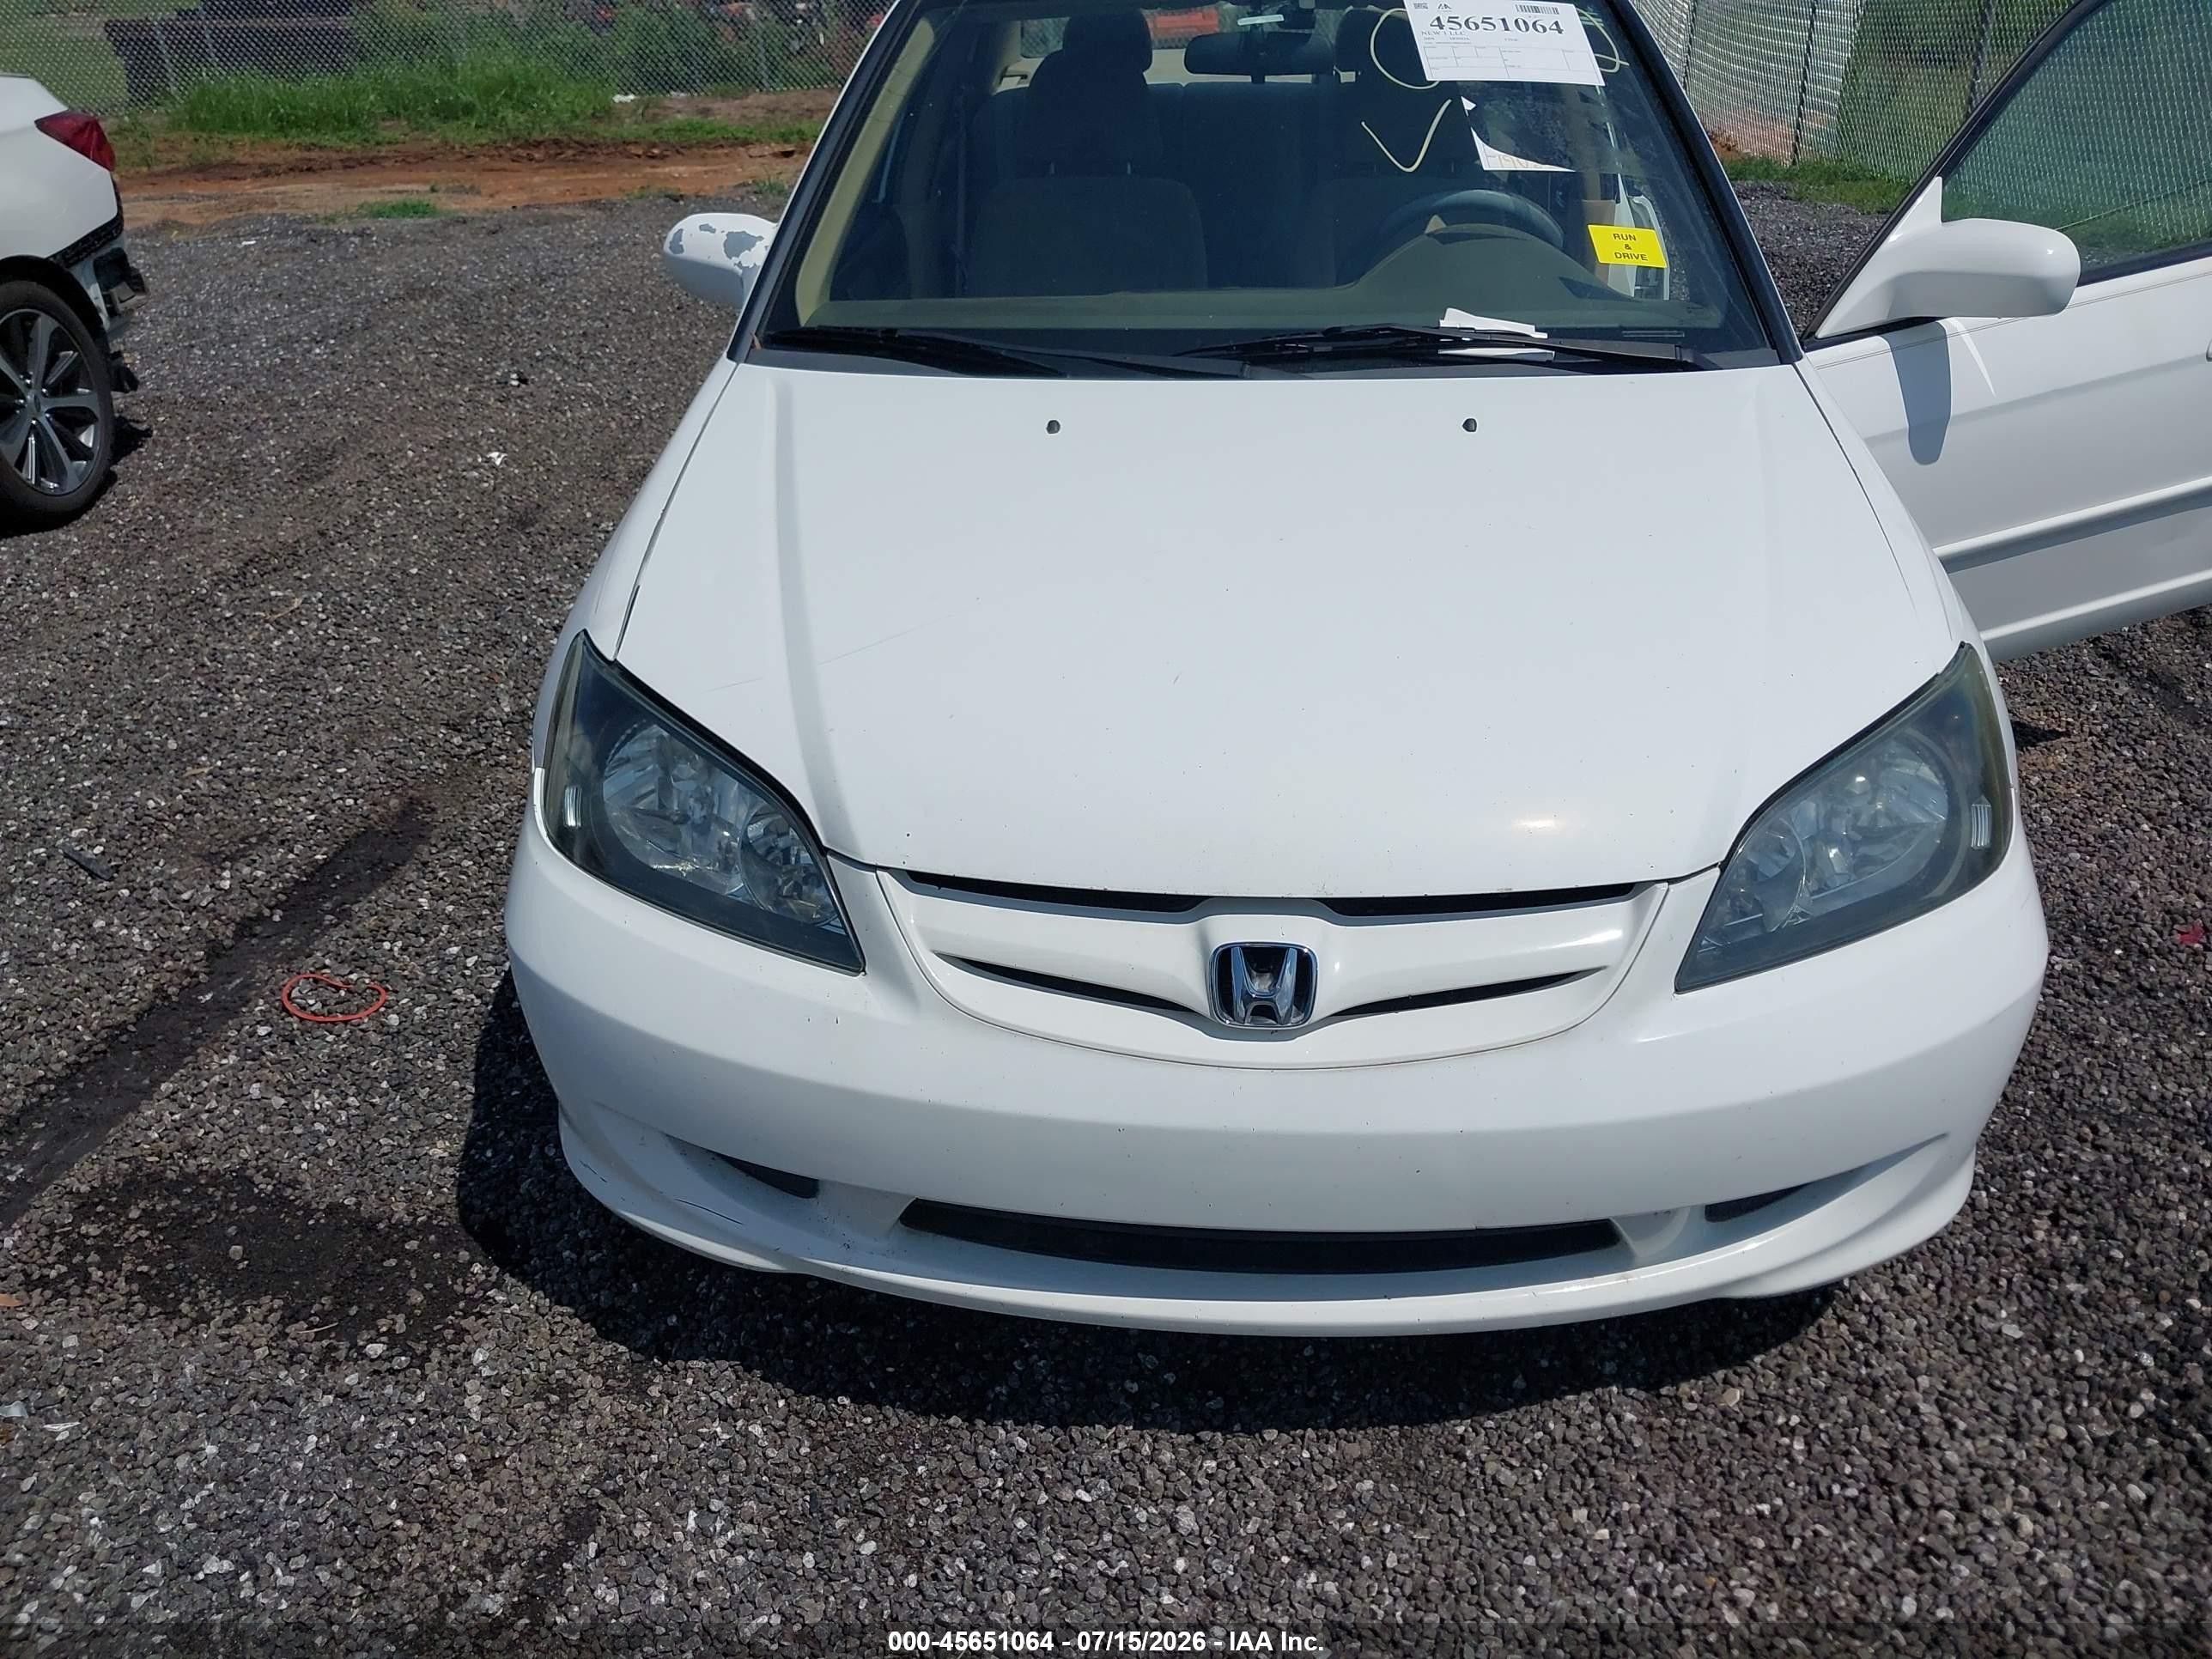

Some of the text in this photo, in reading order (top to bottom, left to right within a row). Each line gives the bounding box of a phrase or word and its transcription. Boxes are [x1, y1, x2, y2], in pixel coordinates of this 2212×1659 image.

[1429, 15, 1565, 35] 45651064
[1613, 233, 1637, 241] RUN
[1614, 252, 1649, 261] DRIVE
